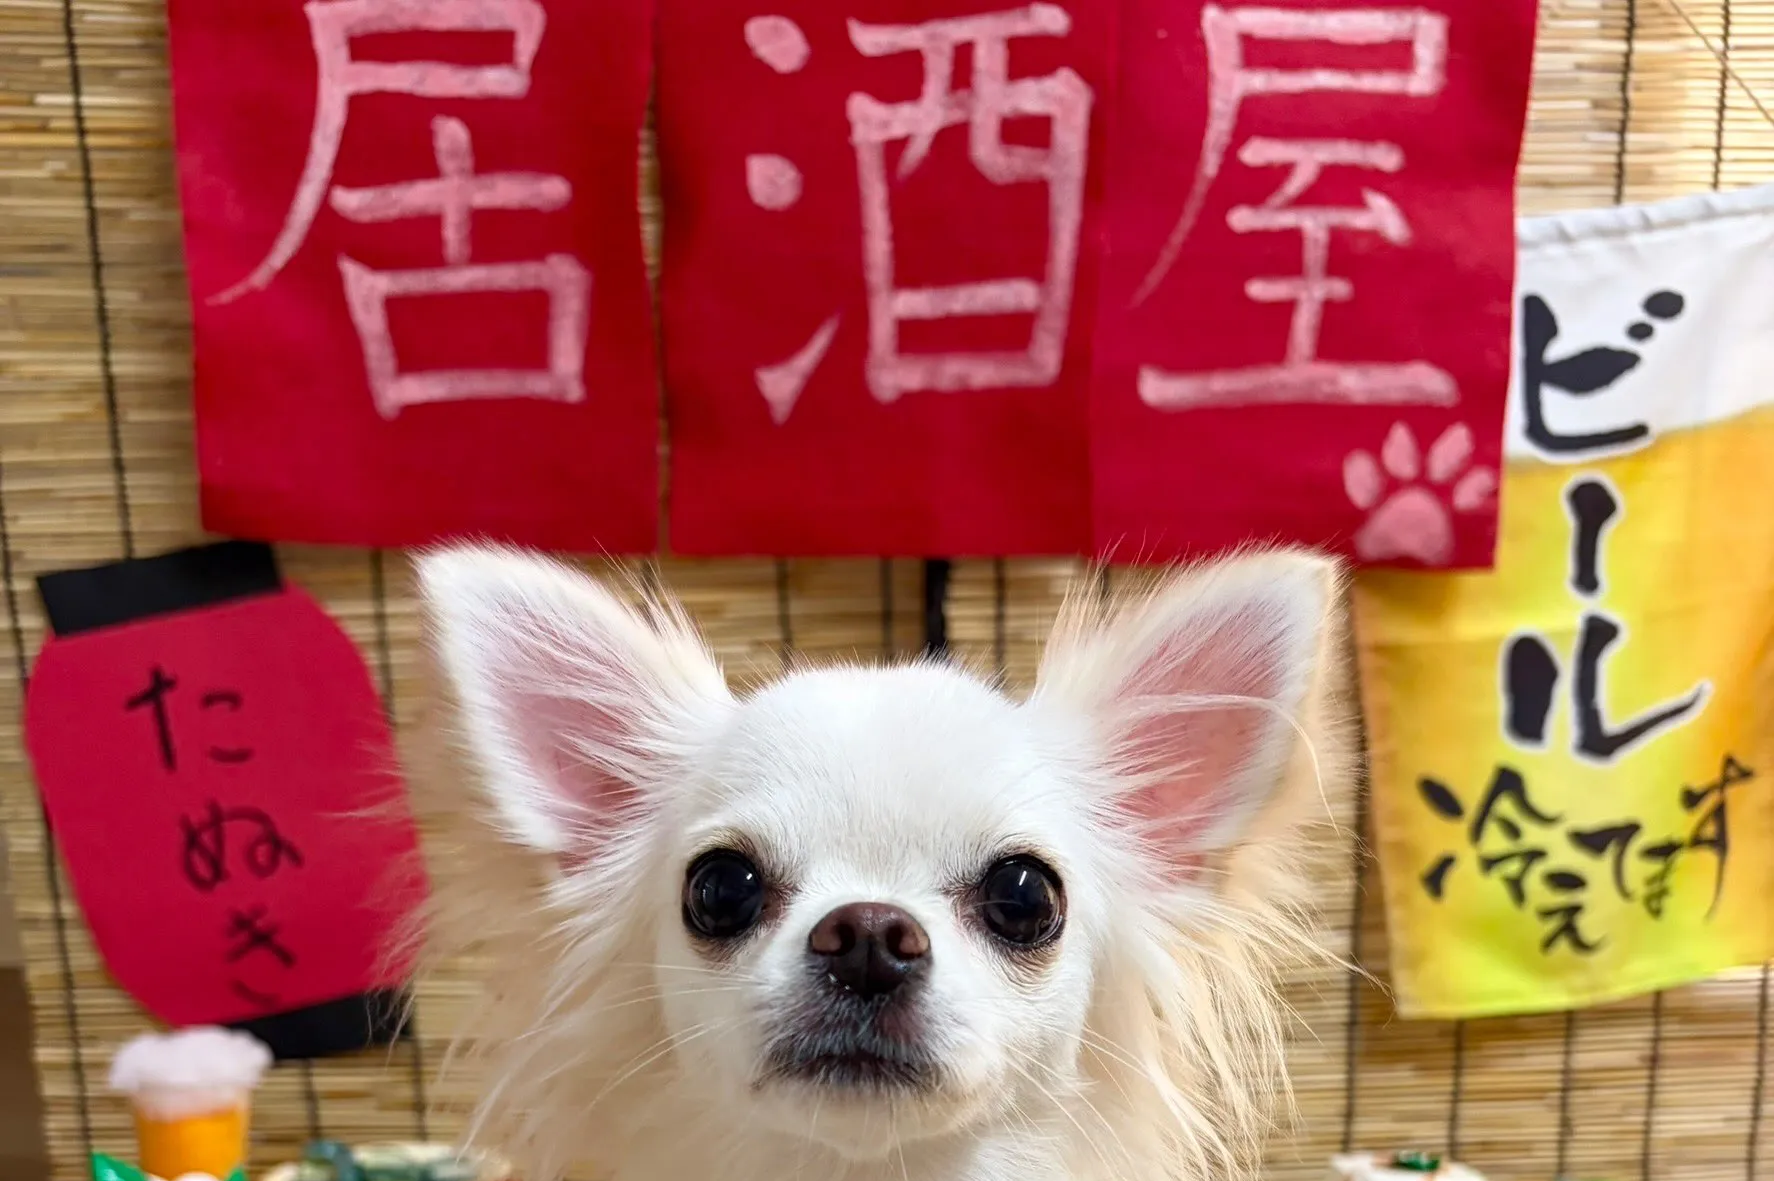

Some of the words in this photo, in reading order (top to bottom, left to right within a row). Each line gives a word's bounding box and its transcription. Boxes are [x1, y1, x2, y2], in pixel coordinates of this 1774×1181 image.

[206, 0, 1458, 422] 居酒屋
[1504, 290, 1708, 758] ビール
[124, 664, 303, 1007] たぬき
[1418, 754, 1756, 955] 冷えてます
